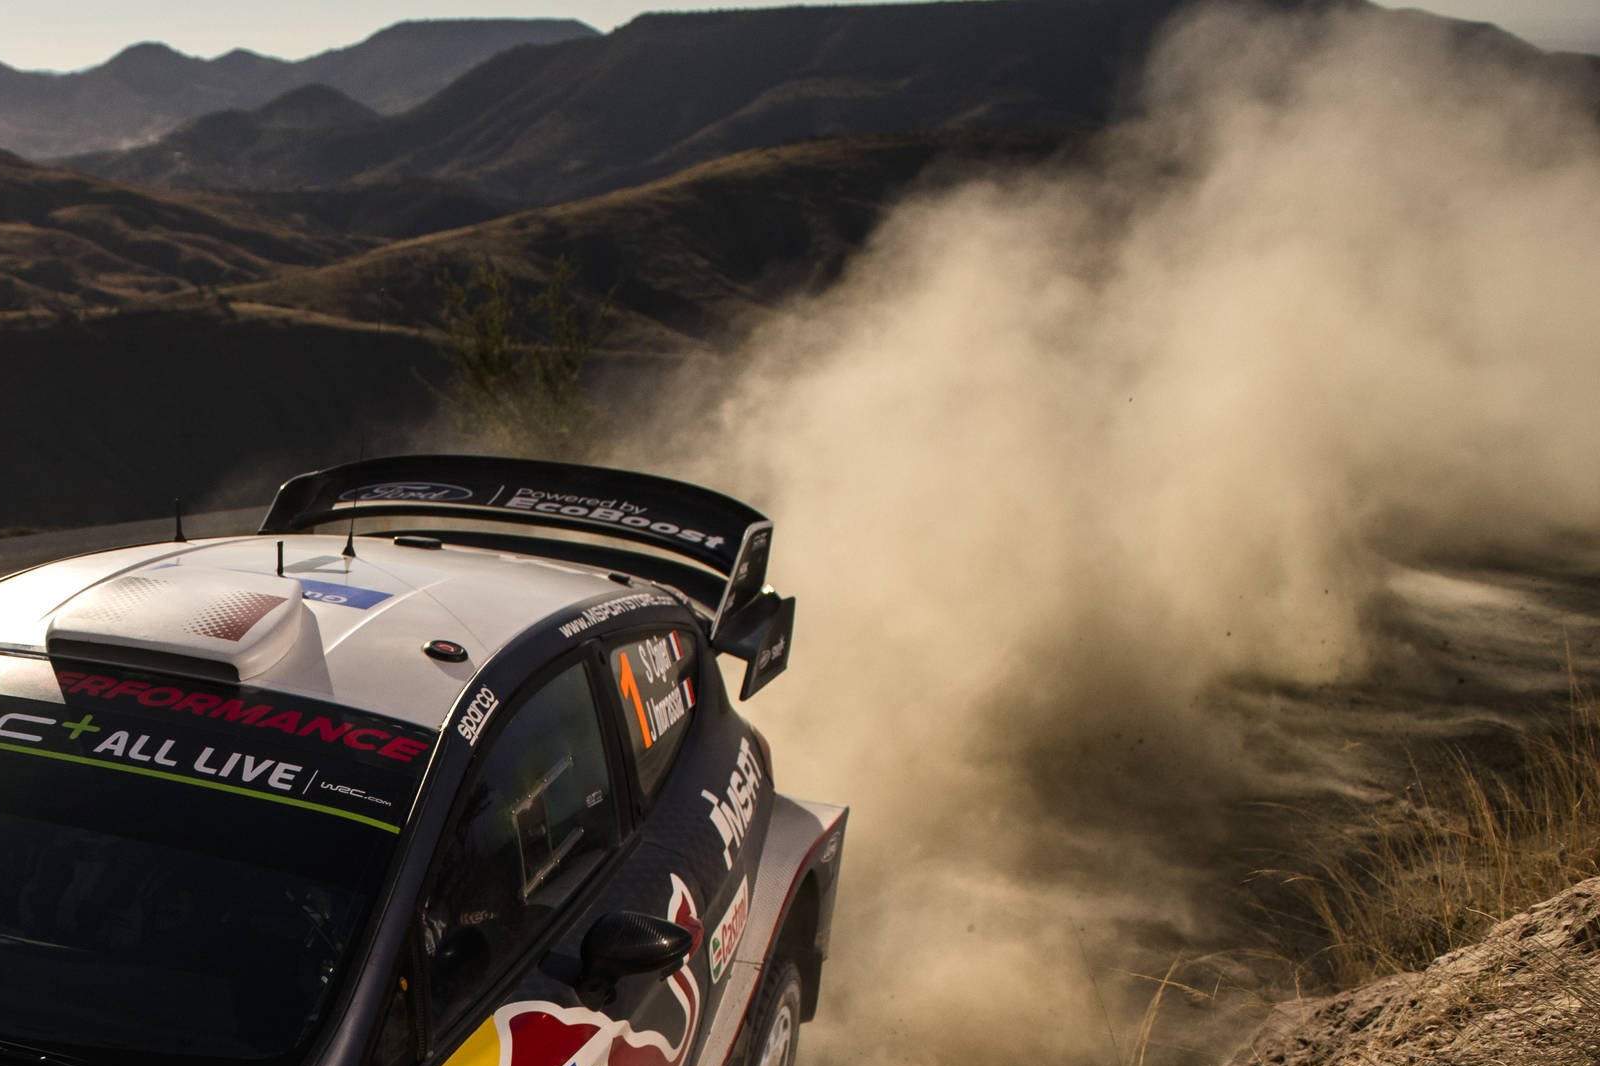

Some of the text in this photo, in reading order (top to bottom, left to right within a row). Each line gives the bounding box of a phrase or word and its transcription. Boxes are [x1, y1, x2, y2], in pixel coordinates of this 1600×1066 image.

[360, 484, 452, 502] Ford
[516, 487, 649, 516] Powered by
[505, 496, 727, 550] EcoBoost
[54, 671, 430, 763] ERFORMANCE
[456, 686, 496, 742] sparco
[619, 651, 653, 749] 1
[93, 729, 180, 768] ALL
[192, 746, 303, 792] LIVE
